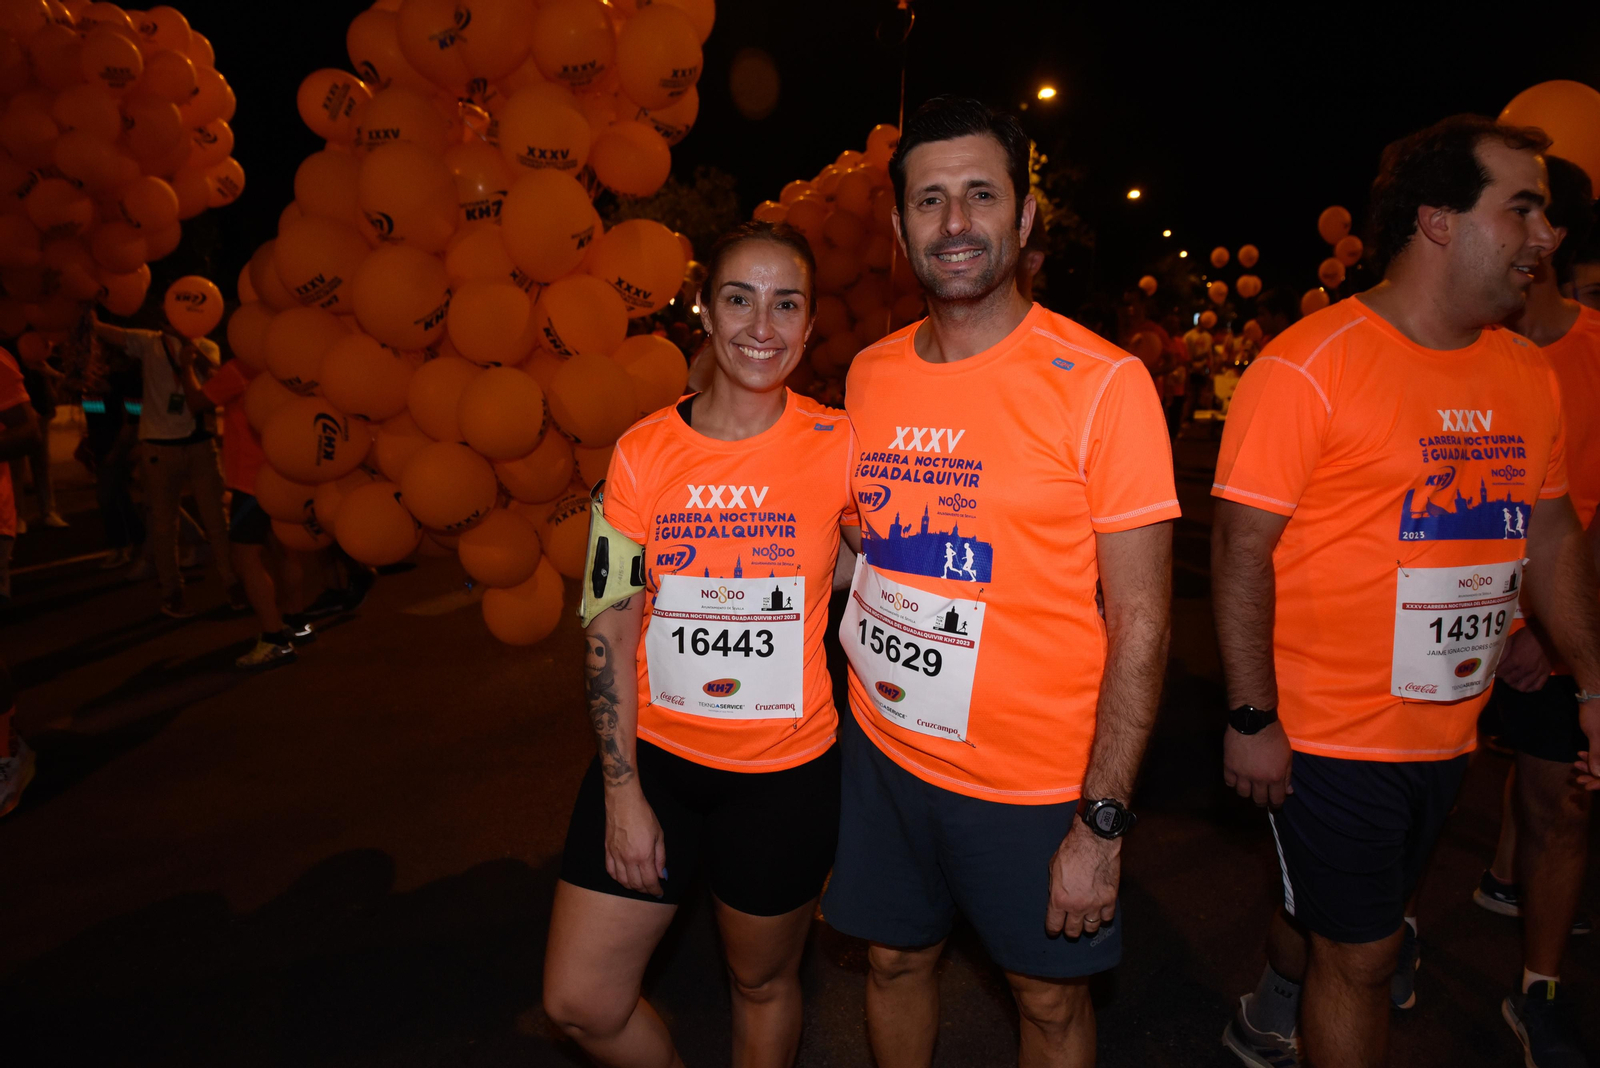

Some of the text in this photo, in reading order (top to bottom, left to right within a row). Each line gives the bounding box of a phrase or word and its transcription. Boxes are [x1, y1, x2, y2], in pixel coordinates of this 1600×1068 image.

[527, 145, 570, 161] XXXV
[465, 200, 503, 221] KH7
[614, 276, 652, 300] XXXV
[1437, 409, 1493, 433] XXXV
[322, 422, 338, 461] KH7
[888, 426, 966, 454] XXXV
[1419, 435, 1525, 447] CARRERA NOCTURNA
[860, 452, 983, 471] CARRERA NOCTURNA
[1430, 447, 1527, 461] GUADALQUIVIR
[860, 465, 980, 488] GUADALQUIVIR
[685, 484, 770, 509] XXXV
[554, 504, 587, 527] XXXV
[655, 512, 797, 525] CARRERA NOCTURNA
[661, 525, 797, 540] GUADALQUIVIR
[1402, 531, 1425, 539] 2023
[903, 625, 944, 641] GUADALQUIVIR
[956, 638, 971, 647] 2023
[1429, 609, 1506, 644] 14319
[672, 626, 775, 658] 16443
[858, 618, 943, 677] 15629
[1447, 646, 1470, 655] IGNACIO
[755, 702, 796, 711] Cruzcampo
[916, 718, 958, 735] Cruzcampo
